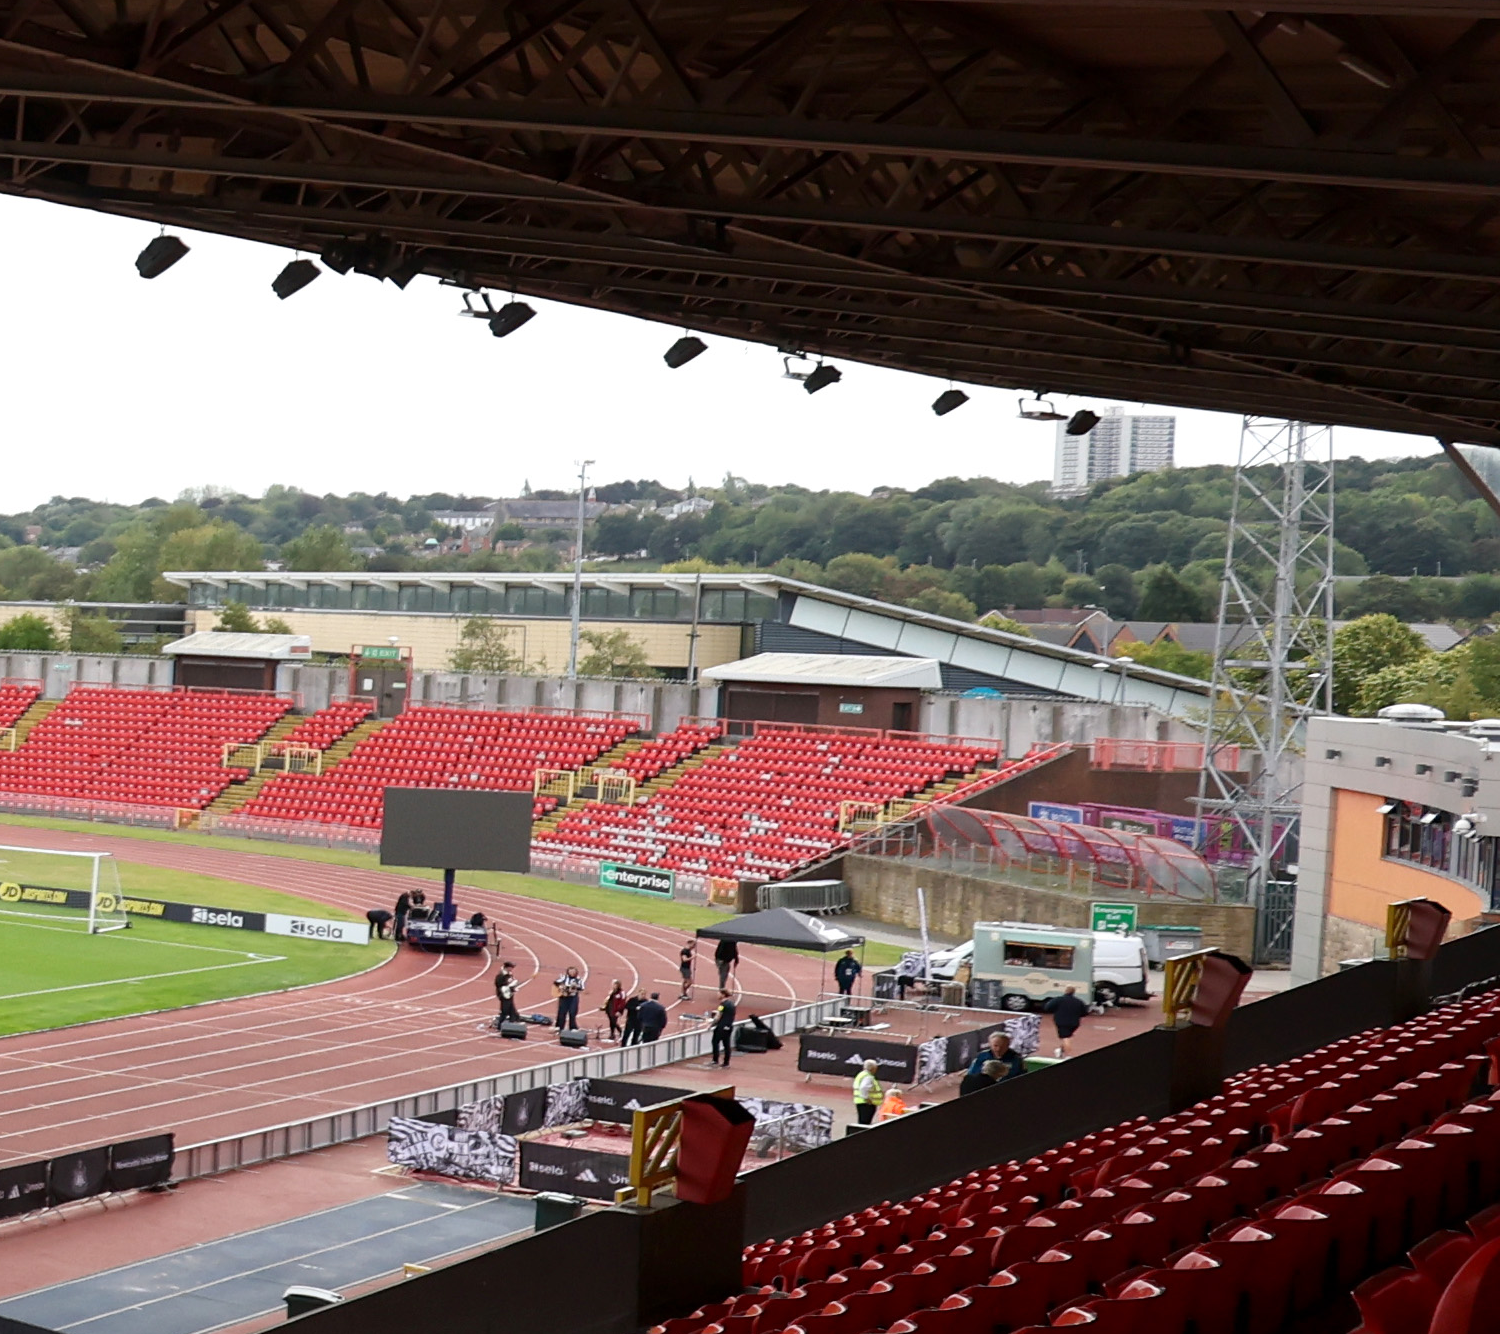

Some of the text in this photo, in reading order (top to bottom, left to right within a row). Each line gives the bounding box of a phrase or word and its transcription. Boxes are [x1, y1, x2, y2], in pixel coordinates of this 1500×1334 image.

[604, 869, 671, 889] enterprise
[2, 886, 19, 898] JD
[1094, 907, 1134, 915] Emergency
[208, 912, 243, 928] sela
[307, 923, 343, 940] sela
